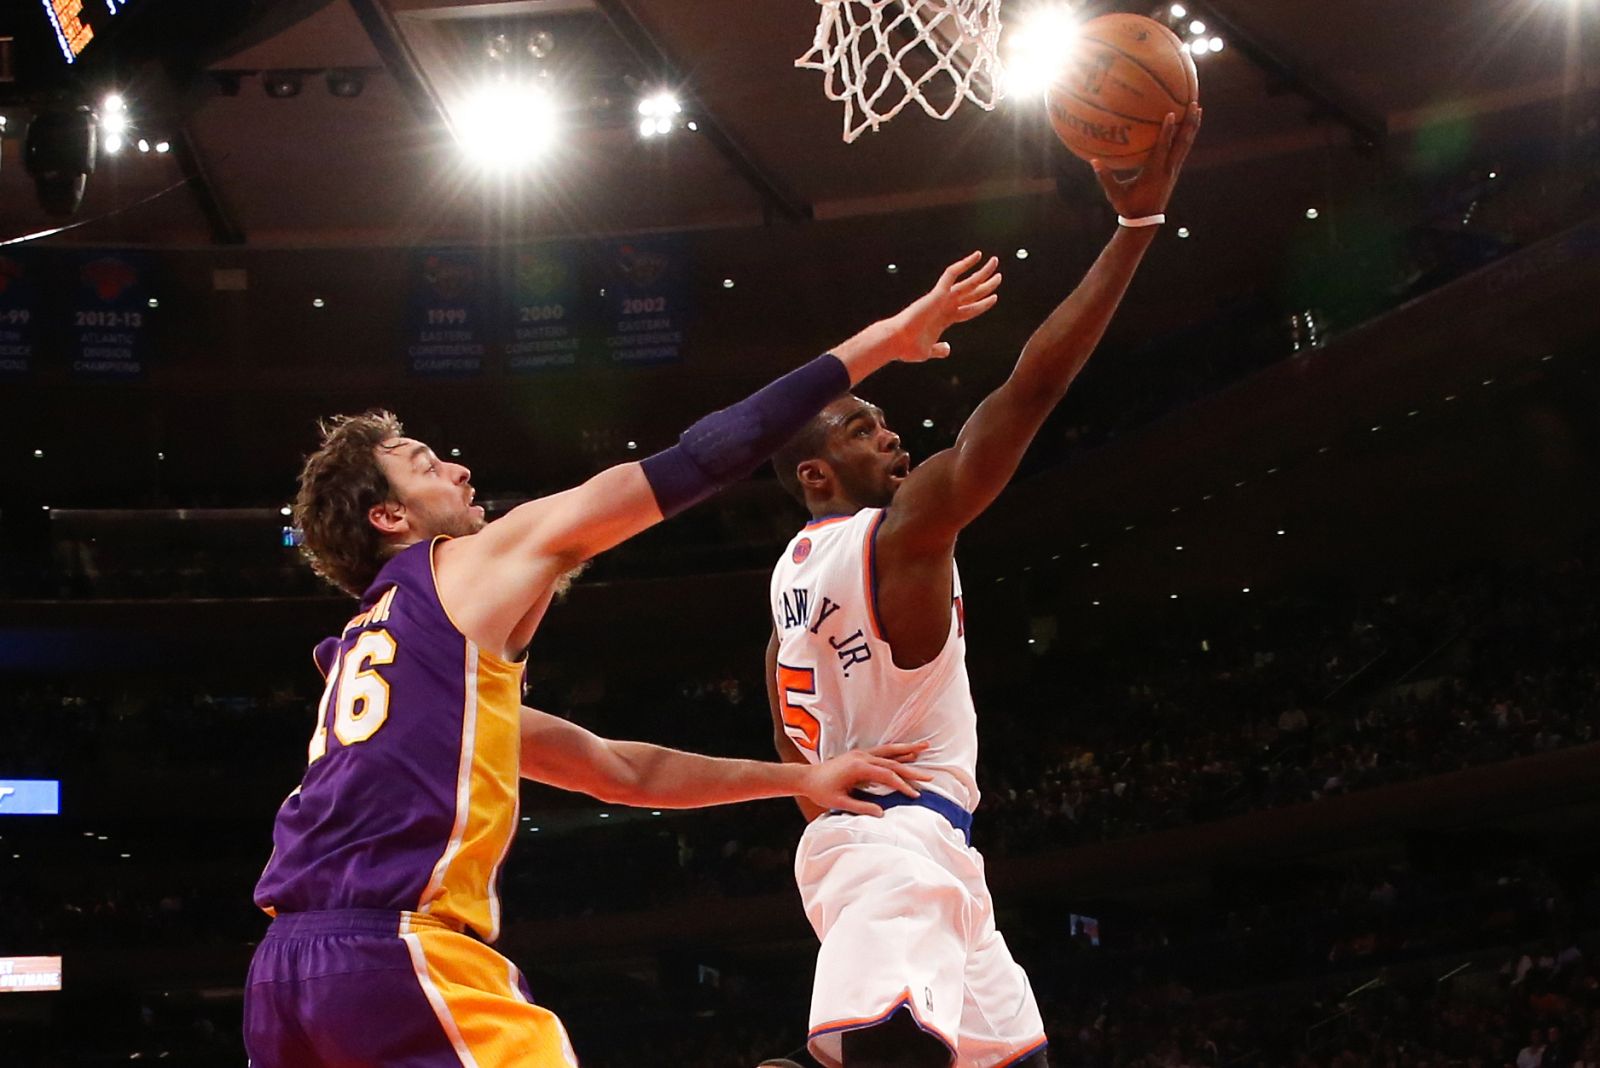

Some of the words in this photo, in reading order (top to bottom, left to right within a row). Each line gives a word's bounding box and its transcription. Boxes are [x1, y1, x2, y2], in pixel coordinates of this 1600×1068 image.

[520, 304, 564, 322] 2000
[621, 297, 665, 314] 2002
[75, 311, 142, 327] 2012-13
[428, 308, 467, 324] 1999
[80, 332, 135, 345] ATLANTIC
[82, 346, 132, 359] DIVISION
[73, 360, 140, 373] CHAMPIONS
[829, 629, 872, 678] JR.
[777, 663, 821, 761] 5
